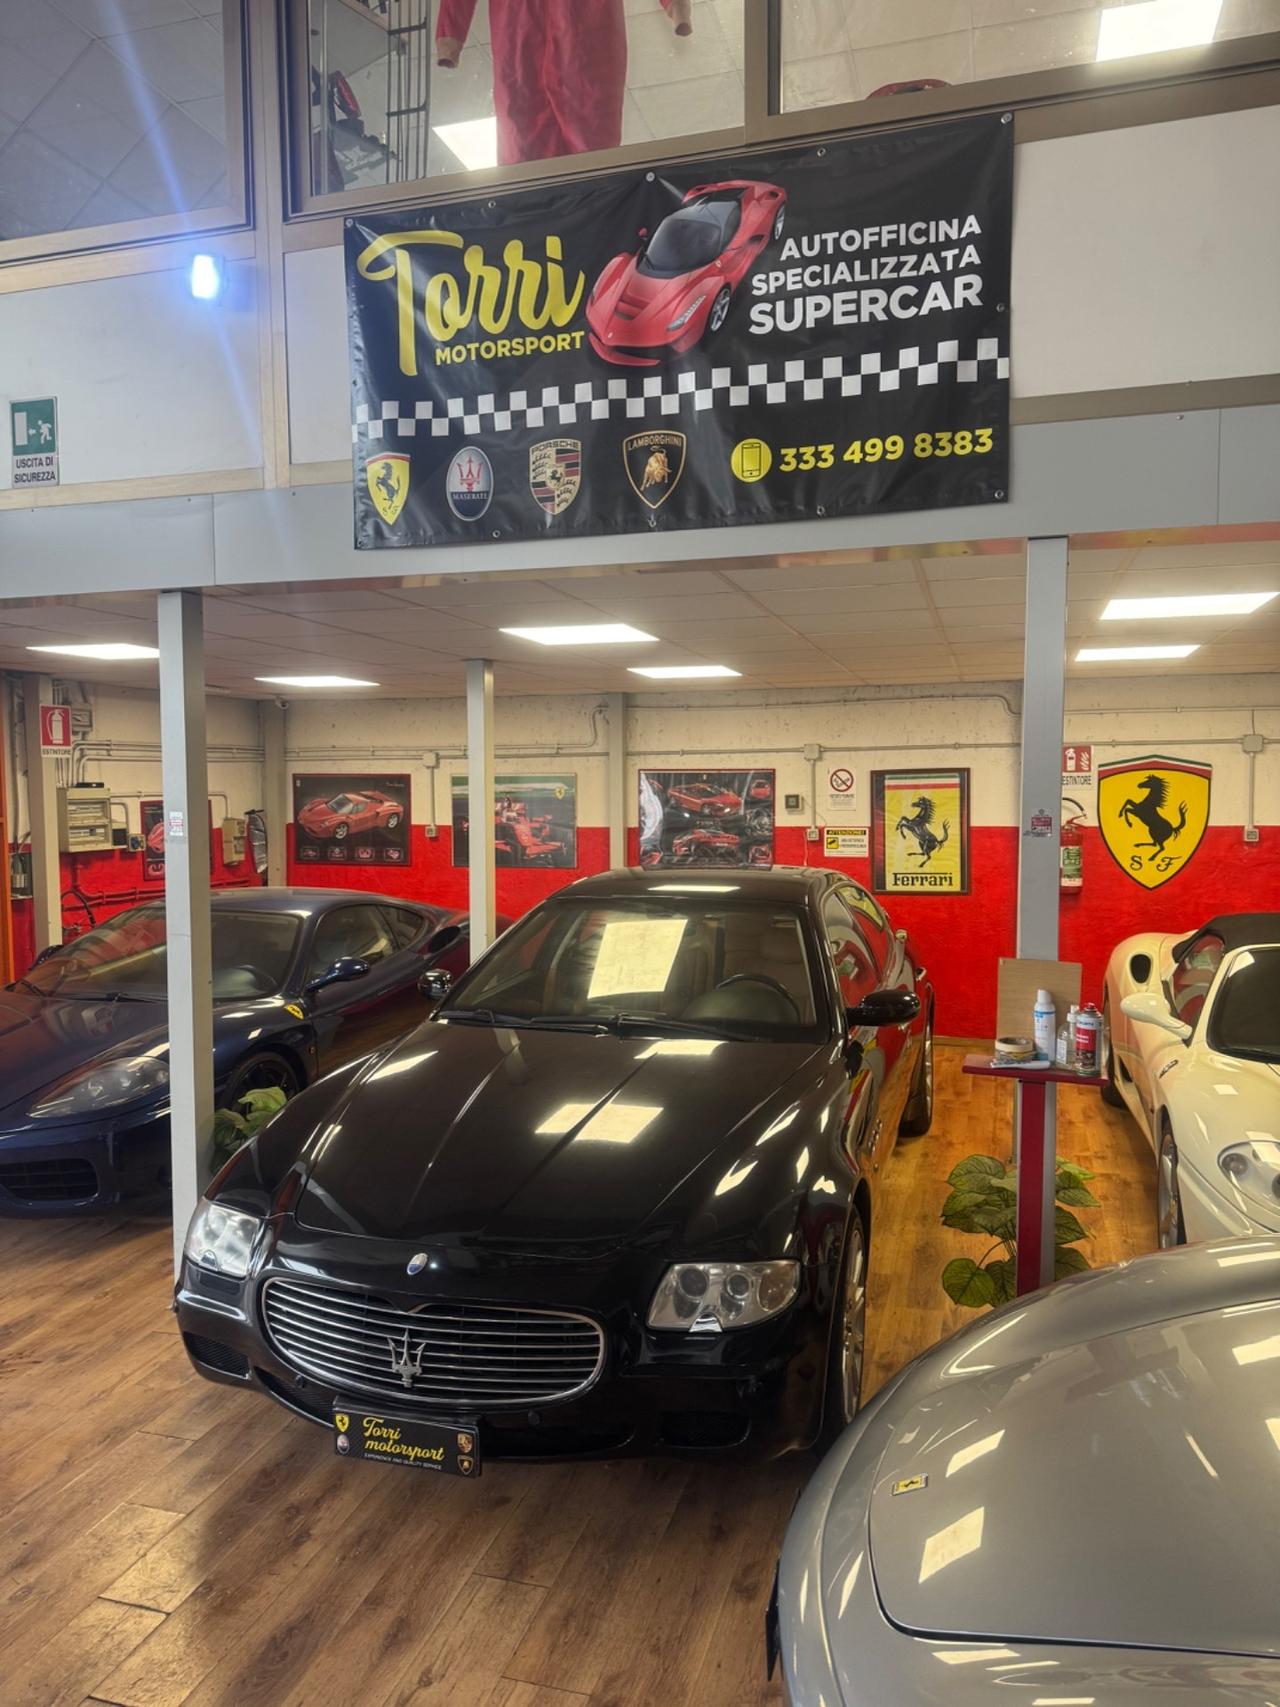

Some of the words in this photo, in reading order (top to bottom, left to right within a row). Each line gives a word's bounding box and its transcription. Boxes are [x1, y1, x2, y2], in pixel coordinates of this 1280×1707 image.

[780, 214, 982, 261] AUTOFFICINA
[751, 244, 981, 296] SPECIALIZZATA
[357, 230, 585, 376] Torri
[748, 273, 984, 335] SUPERCAR
[435, 331, 585, 366] MOTORSPORT
[627, 435, 683, 451] LAMBORGHINI
[779, 443, 835, 472] 333
[843, 434, 905, 464] 499
[913, 427, 993, 458] 8383
[16, 458, 43, 468] USCITA
[45, 456, 53, 466] DI
[14, 470, 56, 483] SICUREZZA
[892, 872, 954, 886] Ferrari
[363, 1417, 402, 1439] Torri
[364, 1439, 446, 1461] motorsport
